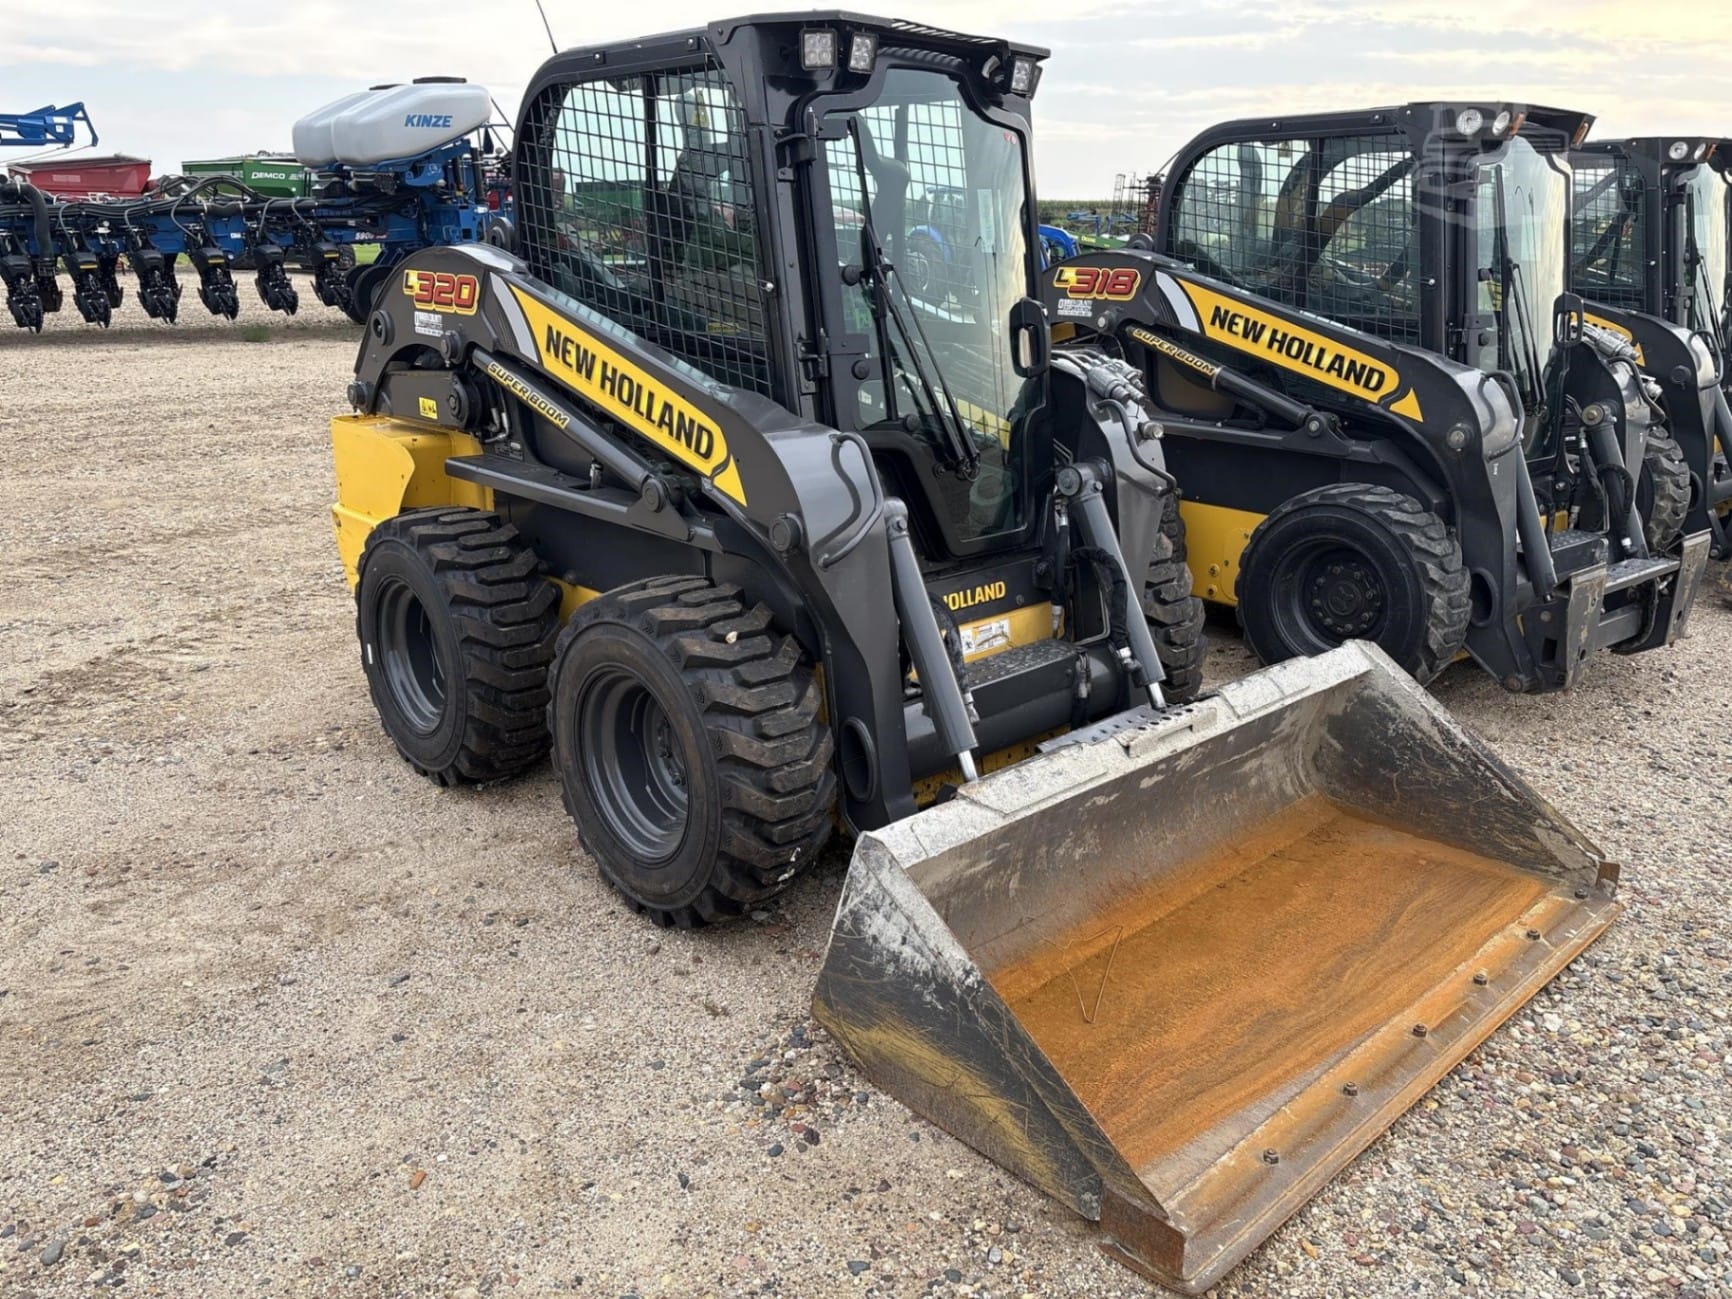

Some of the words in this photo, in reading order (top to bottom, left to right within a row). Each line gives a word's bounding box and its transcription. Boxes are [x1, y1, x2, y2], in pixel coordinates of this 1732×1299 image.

[404, 114, 453, 128] KINZE
[251, 171, 286, 179] DEMCO
[403, 270, 479, 315] L320
[1053, 267, 1140, 300] L318
[1133, 328, 1177, 355] SUPER
[1175, 348, 1217, 376] BOOM
[1210, 304, 1267, 342] NEW
[1267, 328, 1386, 392] HOLLAND
[488, 362, 531, 400] SUPER
[528, 392, 570, 429] BOOM
[546, 324, 597, 381] NEW
[600, 360, 715, 460] HOLLAND
